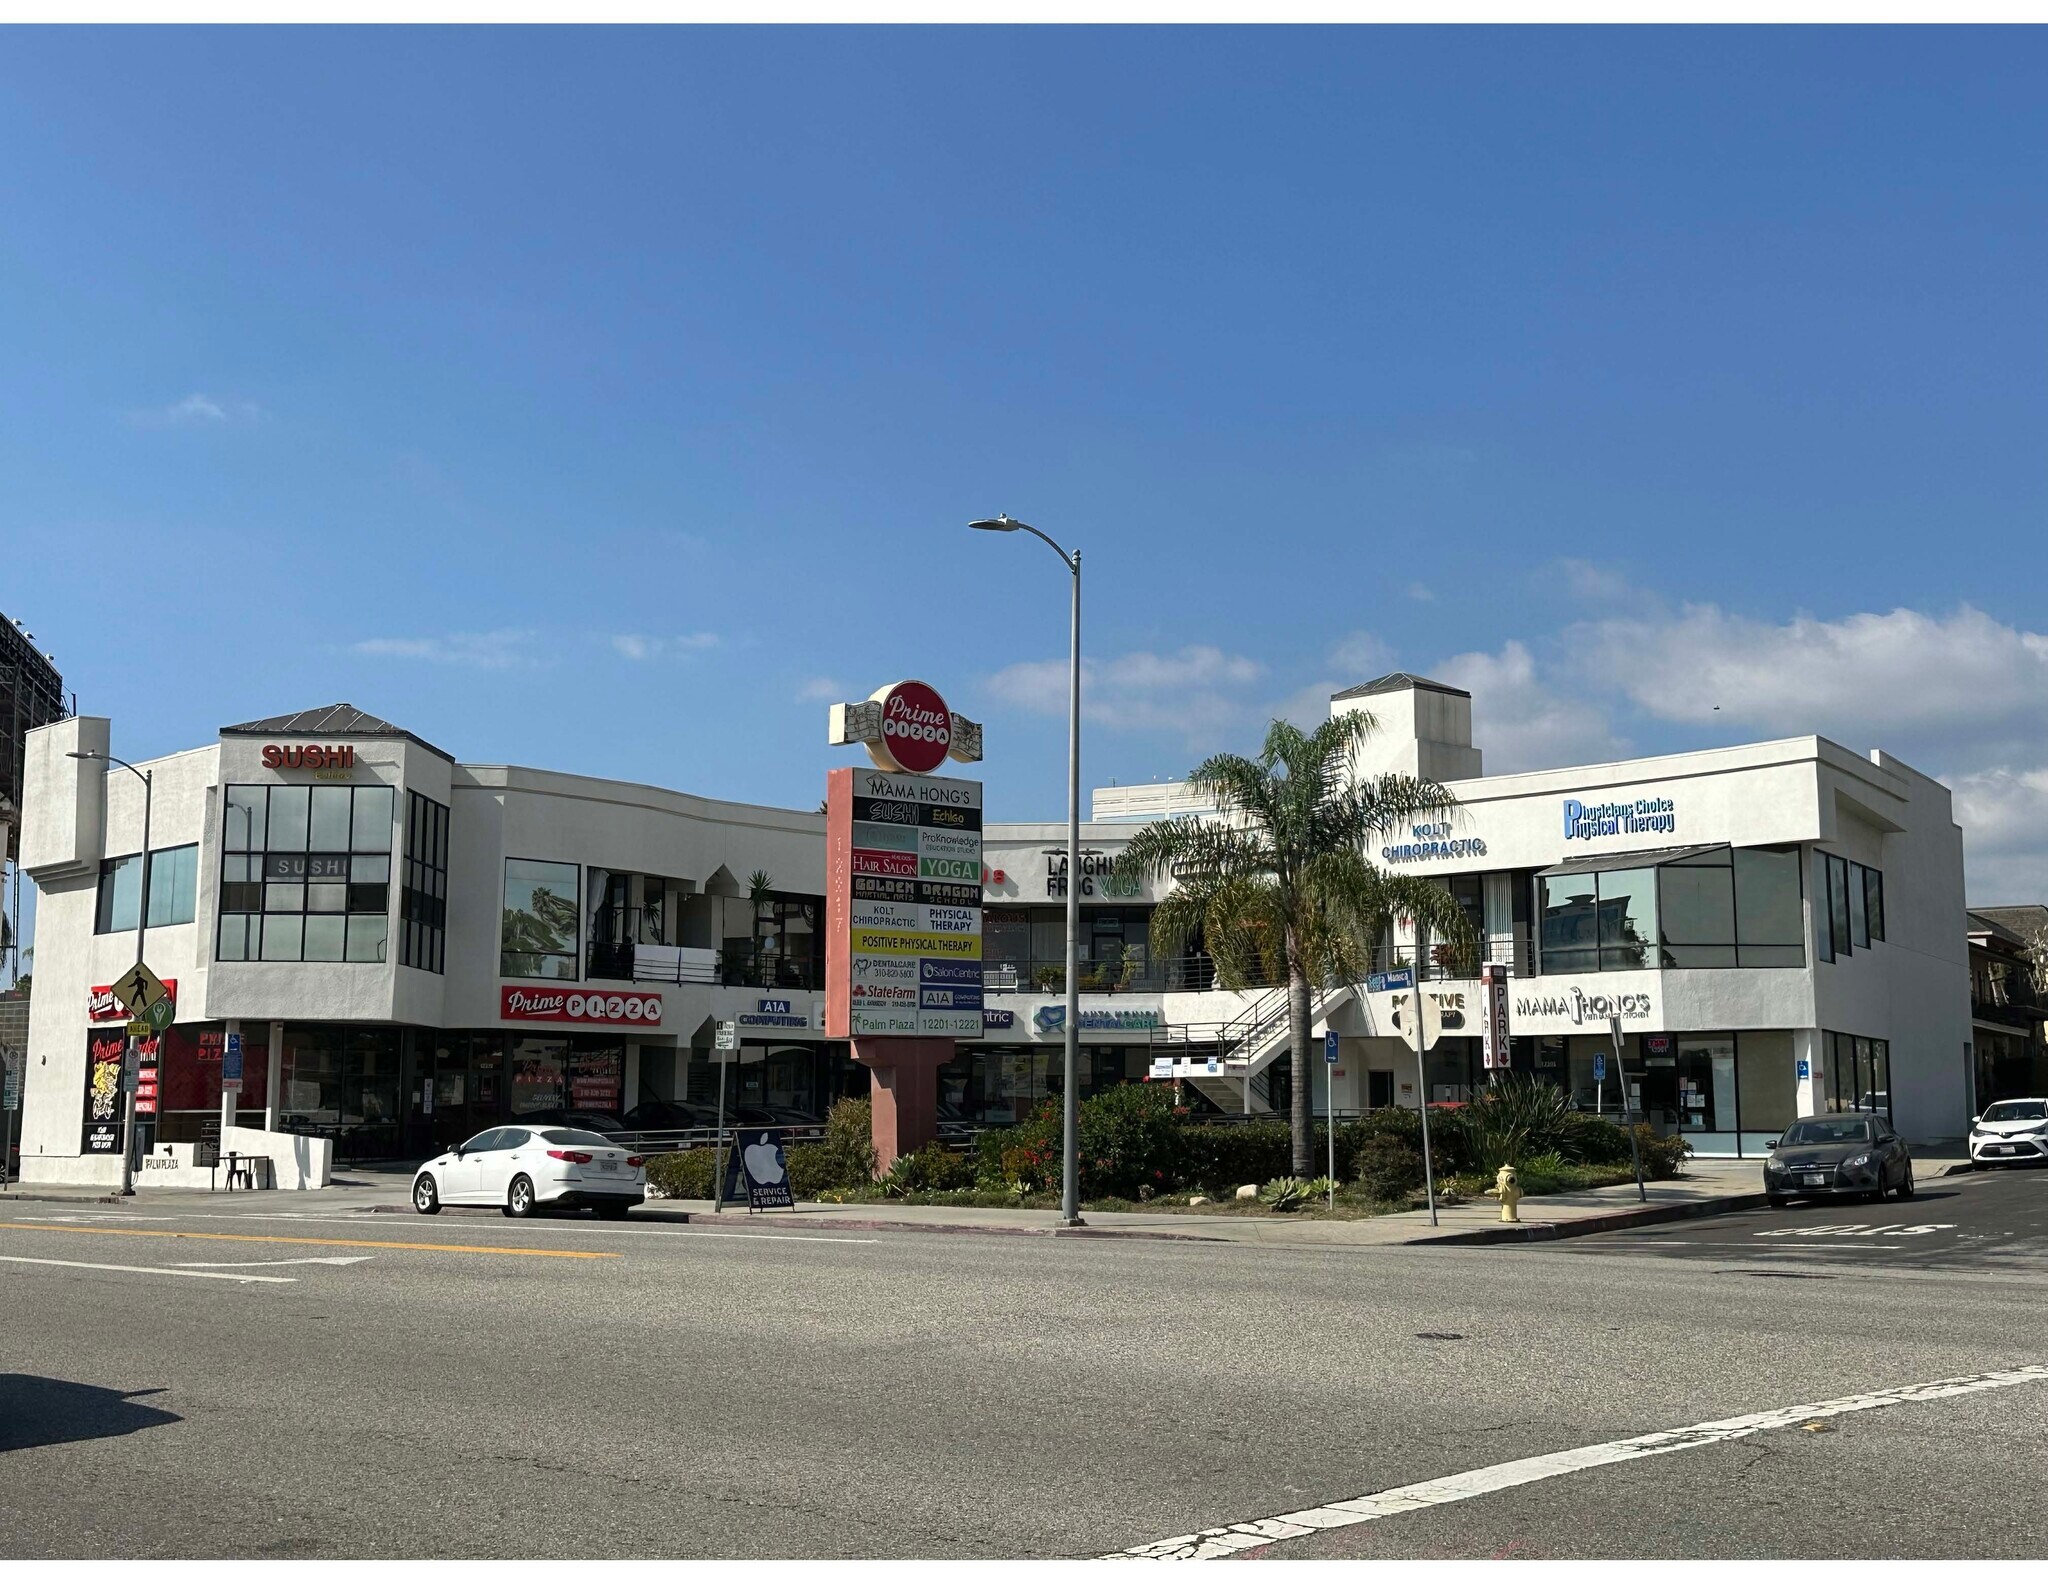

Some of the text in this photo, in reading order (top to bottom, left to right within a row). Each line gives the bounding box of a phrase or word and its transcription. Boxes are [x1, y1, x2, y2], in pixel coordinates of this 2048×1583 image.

[888, 694, 945, 726] Prime
[885, 720, 948, 743] PIZZA
[261, 744, 354, 769] SUSHI
[871, 780, 970, 804] MAMA HONG'S
[869, 801, 920, 825] SUSHI
[1634, 797, 1674, 815] Choice
[1412, 821, 1448, 837] KOLT
[1622, 813, 1675, 833] Therapy
[1381, 838, 1482, 858] CHIROPRACTIC
[278, 859, 347, 875] SUSHI
[853, 855, 917, 875] HAIR SALON
[926, 858, 974, 878] YOGA
[855, 878, 980, 899] GOLDEN DRAGON
[1046, 876, 1094, 897] FRG
[873, 906, 895, 916] KOLT
[929, 908, 973, 920] PHYSICAL
[853, 915, 916, 928] CHIROPRACTIC
[930, 920, 972, 932] THERAPY
[862, 935, 898, 949] POSITIVE
[900, 937, 937, 950] PHYSICAL
[939, 940, 973, 952] THERAPY
[87, 991, 115, 1014] Prime
[508, 990, 661, 1018] Prime PIZZA
[764, 1001, 786, 1013] A1A
[1516, 996, 1570, 1016] MAMA
[1581, 993, 1651, 1014] HONG'S
[738, 1014, 808, 1027] COMPUTING
[862, 1018, 915, 1030] Palm Plaza
[922, 1018, 979, 1030] 12201-12221
[1497, 987, 1508, 1051] PARK
[92, 1038, 123, 1063] Prime
[516, 1074, 563, 1084] PIZZA
[752, 1187, 788, 1196] SERVICE
[761, 1195, 791, 1205] REPAIR
